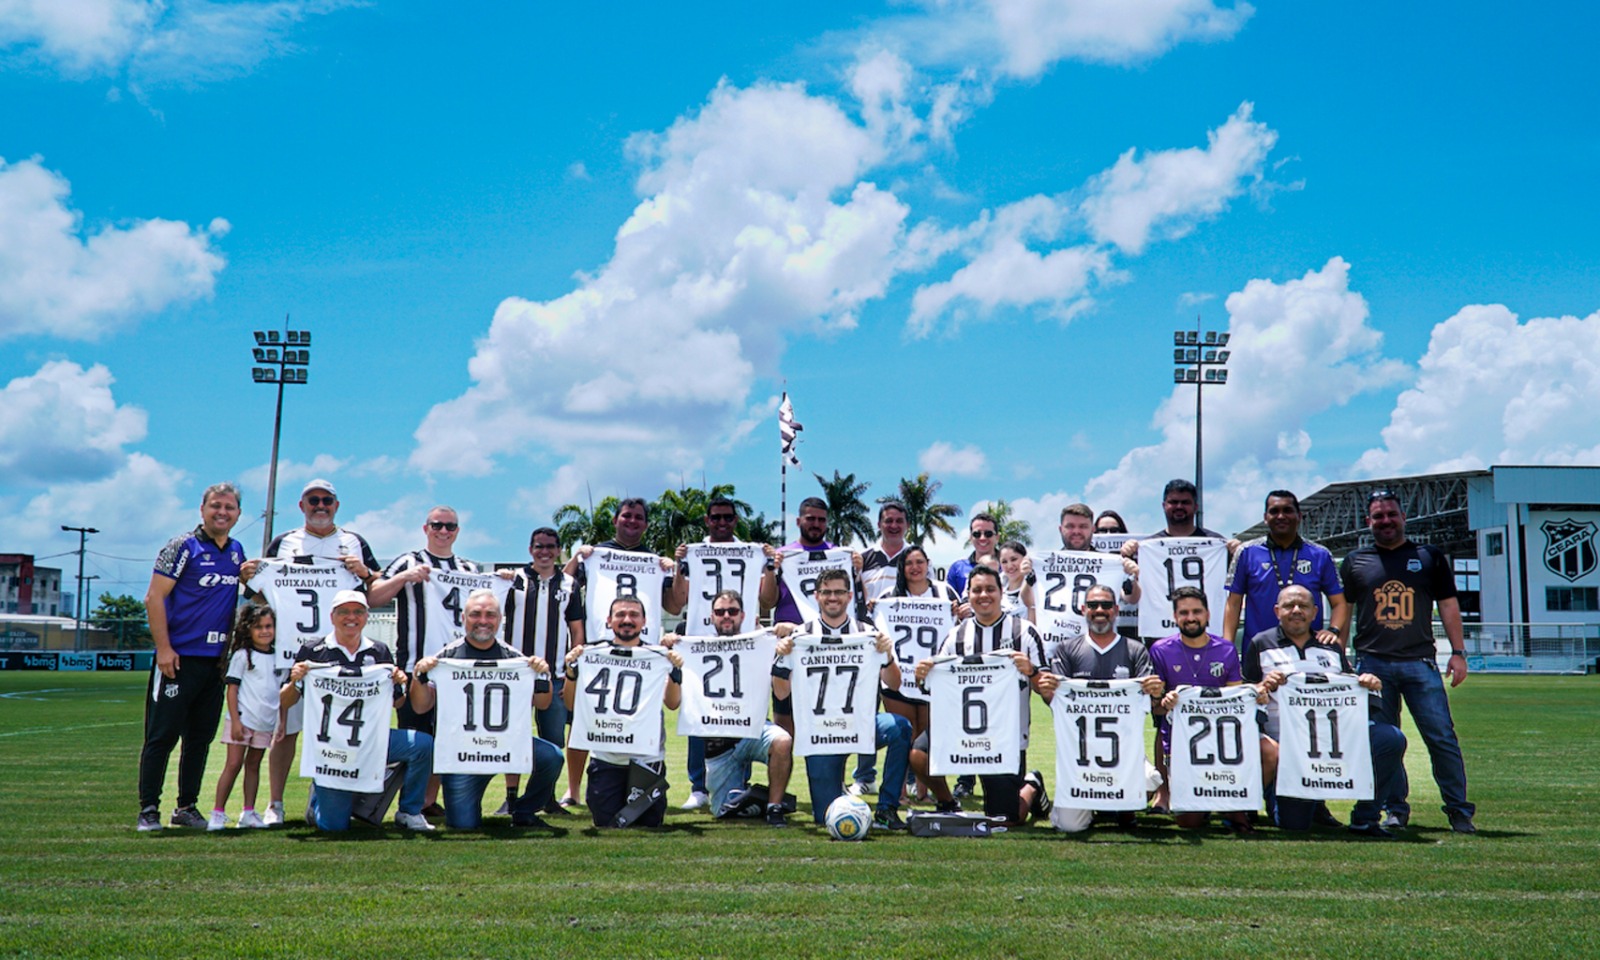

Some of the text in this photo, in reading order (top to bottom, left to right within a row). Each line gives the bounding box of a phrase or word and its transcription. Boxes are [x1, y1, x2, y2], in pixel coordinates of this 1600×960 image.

[613, 553, 653, 563] brisanet
[1057, 554, 1103, 564] brisanet
[287, 564, 336, 574] brisanet
[274, 578, 337, 587] QUIXADÁ/CE
[701, 558, 746, 601] 33
[1163, 556, 1204, 601] 19
[616, 573, 637, 599] 8
[1044, 573, 1097, 616] 28
[296, 589, 319, 633] 3
[901, 602, 943, 611] brisanet
[1374, 592, 1414, 620] 250
[888, 614, 943, 625] LIMOEIRO/CE
[894, 624, 938, 663] 29
[32, 656, 56, 670] bmg
[69, 656, 93, 670] bmg
[107, 656, 132, 670] bmg
[801, 654, 863, 665] CANINDÉ/CE
[452, 670, 520, 681] DALLAS/USA
[703, 654, 743, 698] 21
[958, 675, 992, 684] IPU/CE
[585, 667, 643, 715] 40
[807, 666, 859, 715] 77
[463, 682, 510, 732] 10
[719, 703, 740, 714] bmg
[962, 686, 987, 734] 6
[1066, 704, 1130, 714] ARACATI/CE
[317, 694, 365, 747] 14
[602, 720, 623, 732] bmg
[701, 716, 751, 726] Unimed
[829, 720, 847, 729] bmg
[587, 731, 634, 744] Unimed
[811, 733, 858, 745] Unimed
[1188, 716, 1243, 765] 20
[1305, 709, 1343, 759] 11
[478, 738, 498, 748] bmg
[968, 739, 991, 751] bmg
[1075, 715, 1119, 768] 15
[327, 751, 347, 763] bmg
[458, 752, 510, 762] Unimed
[950, 753, 1002, 764] Unimed
[315, 765, 359, 779] nimed
[1319, 764, 1342, 777] bmg
[1090, 773, 1113, 786] bmg
[1213, 771, 1236, 784] bmg
[1302, 777, 1354, 789] Unimed
[1070, 787, 1124, 799] Unimed
[1194, 786, 1248, 798] Unimed
